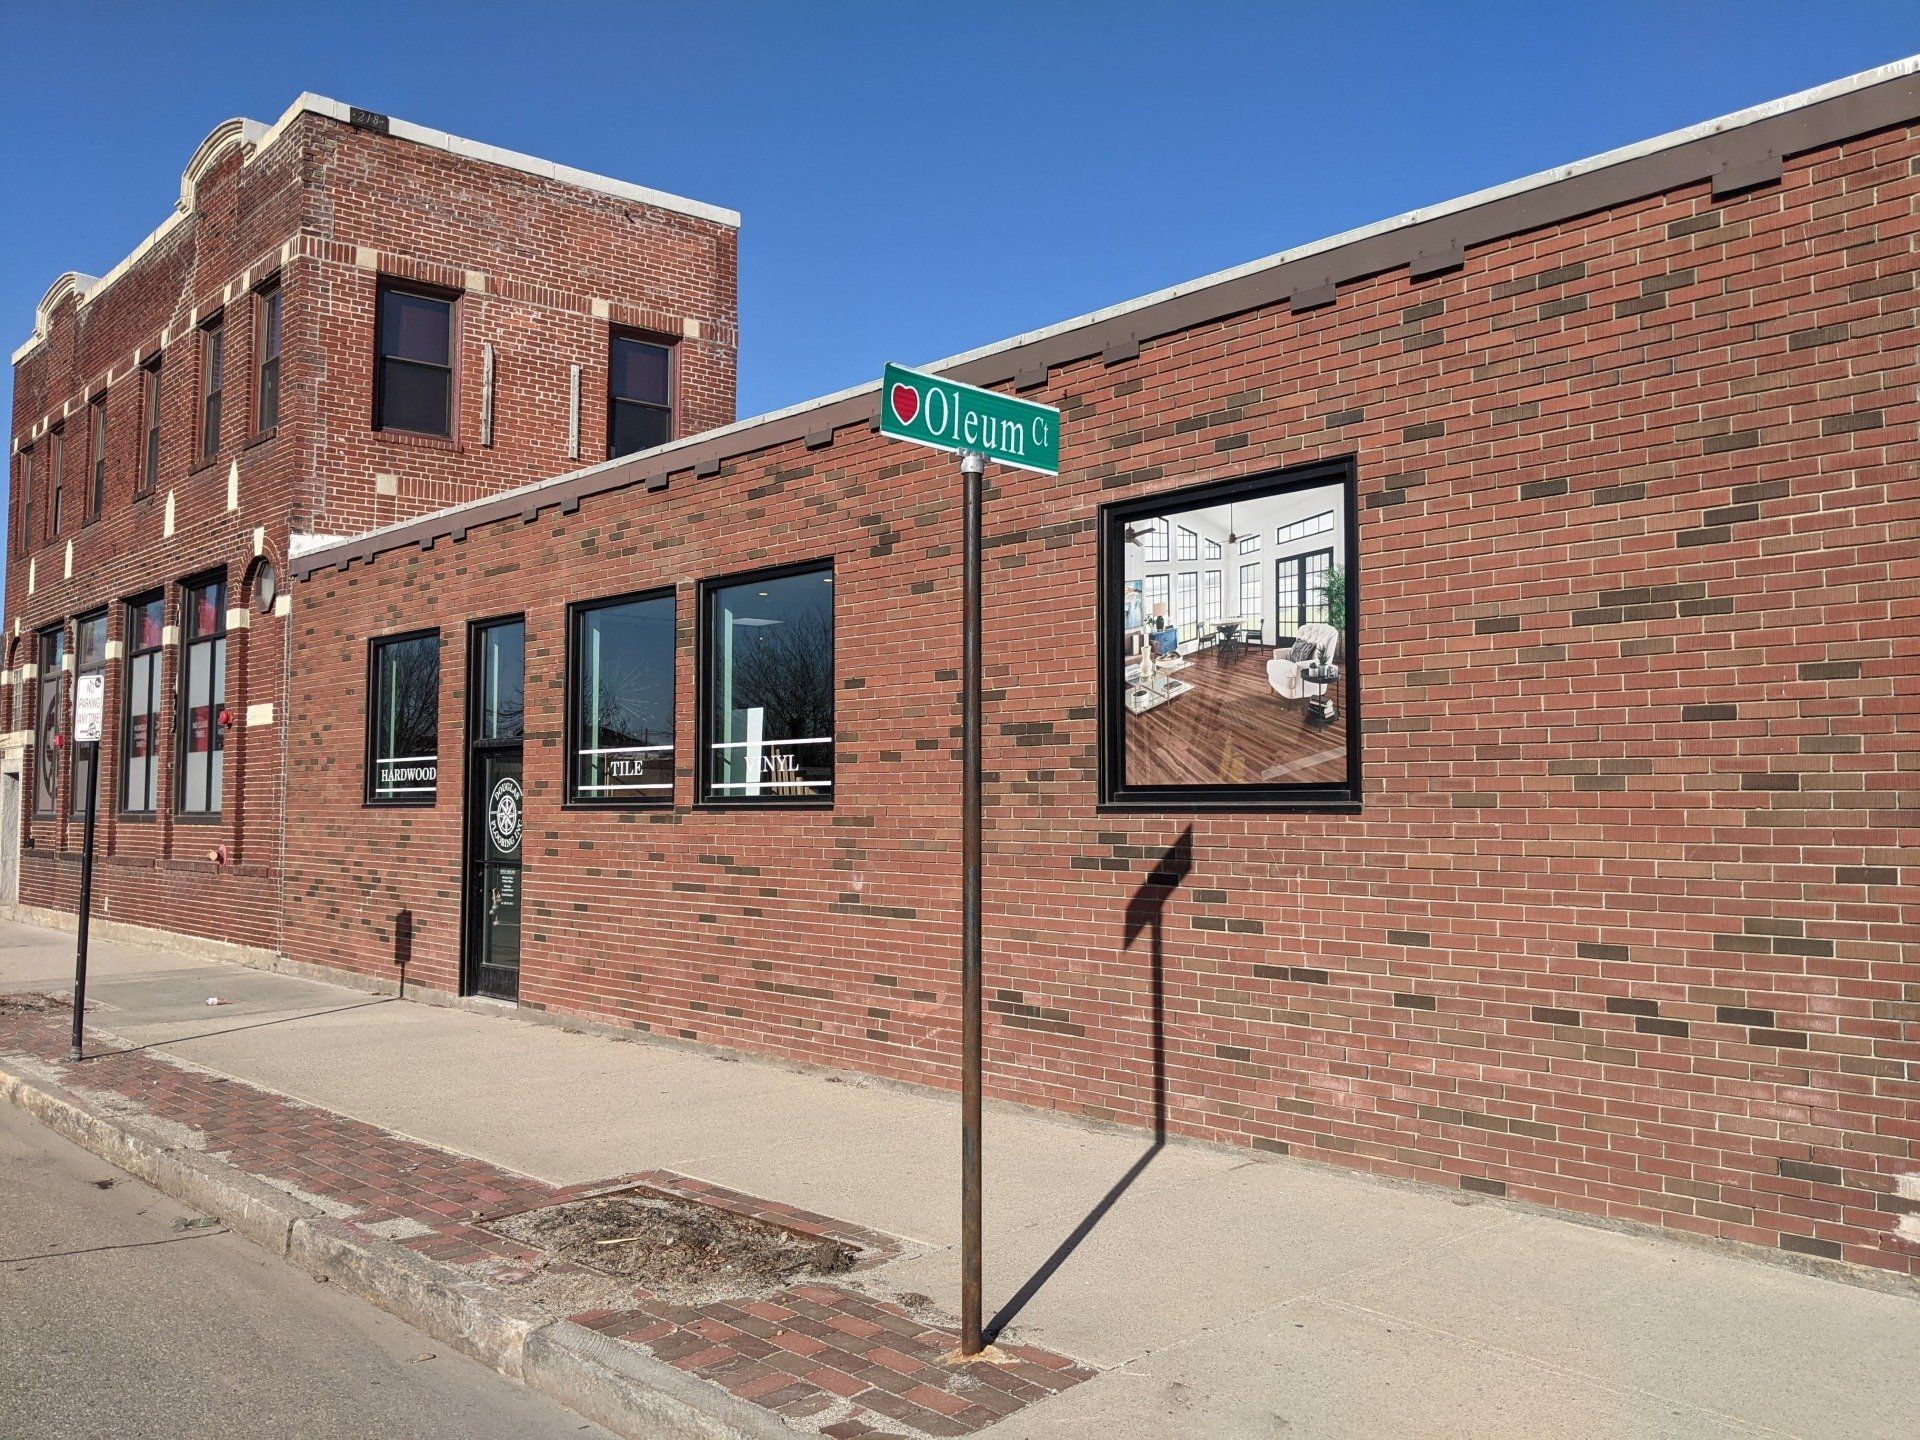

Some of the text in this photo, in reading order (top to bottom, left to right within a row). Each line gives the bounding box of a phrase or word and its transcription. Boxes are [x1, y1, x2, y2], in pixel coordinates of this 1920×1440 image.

[358, 111, 380, 126] 218
[925, 387, 1049, 456] Oleum Ct
[86, 680, 95, 694] NO
[79, 697, 100, 709] PARKING
[77, 712, 100, 724] ANYTIME
[610, 760, 643, 777] TILE
[744, 754, 800, 773] VINYL
[381, 767, 437, 782] HARDWOOD
[494, 782, 520, 801] DOUGLAS
[490, 820, 515, 848] FLOORING
